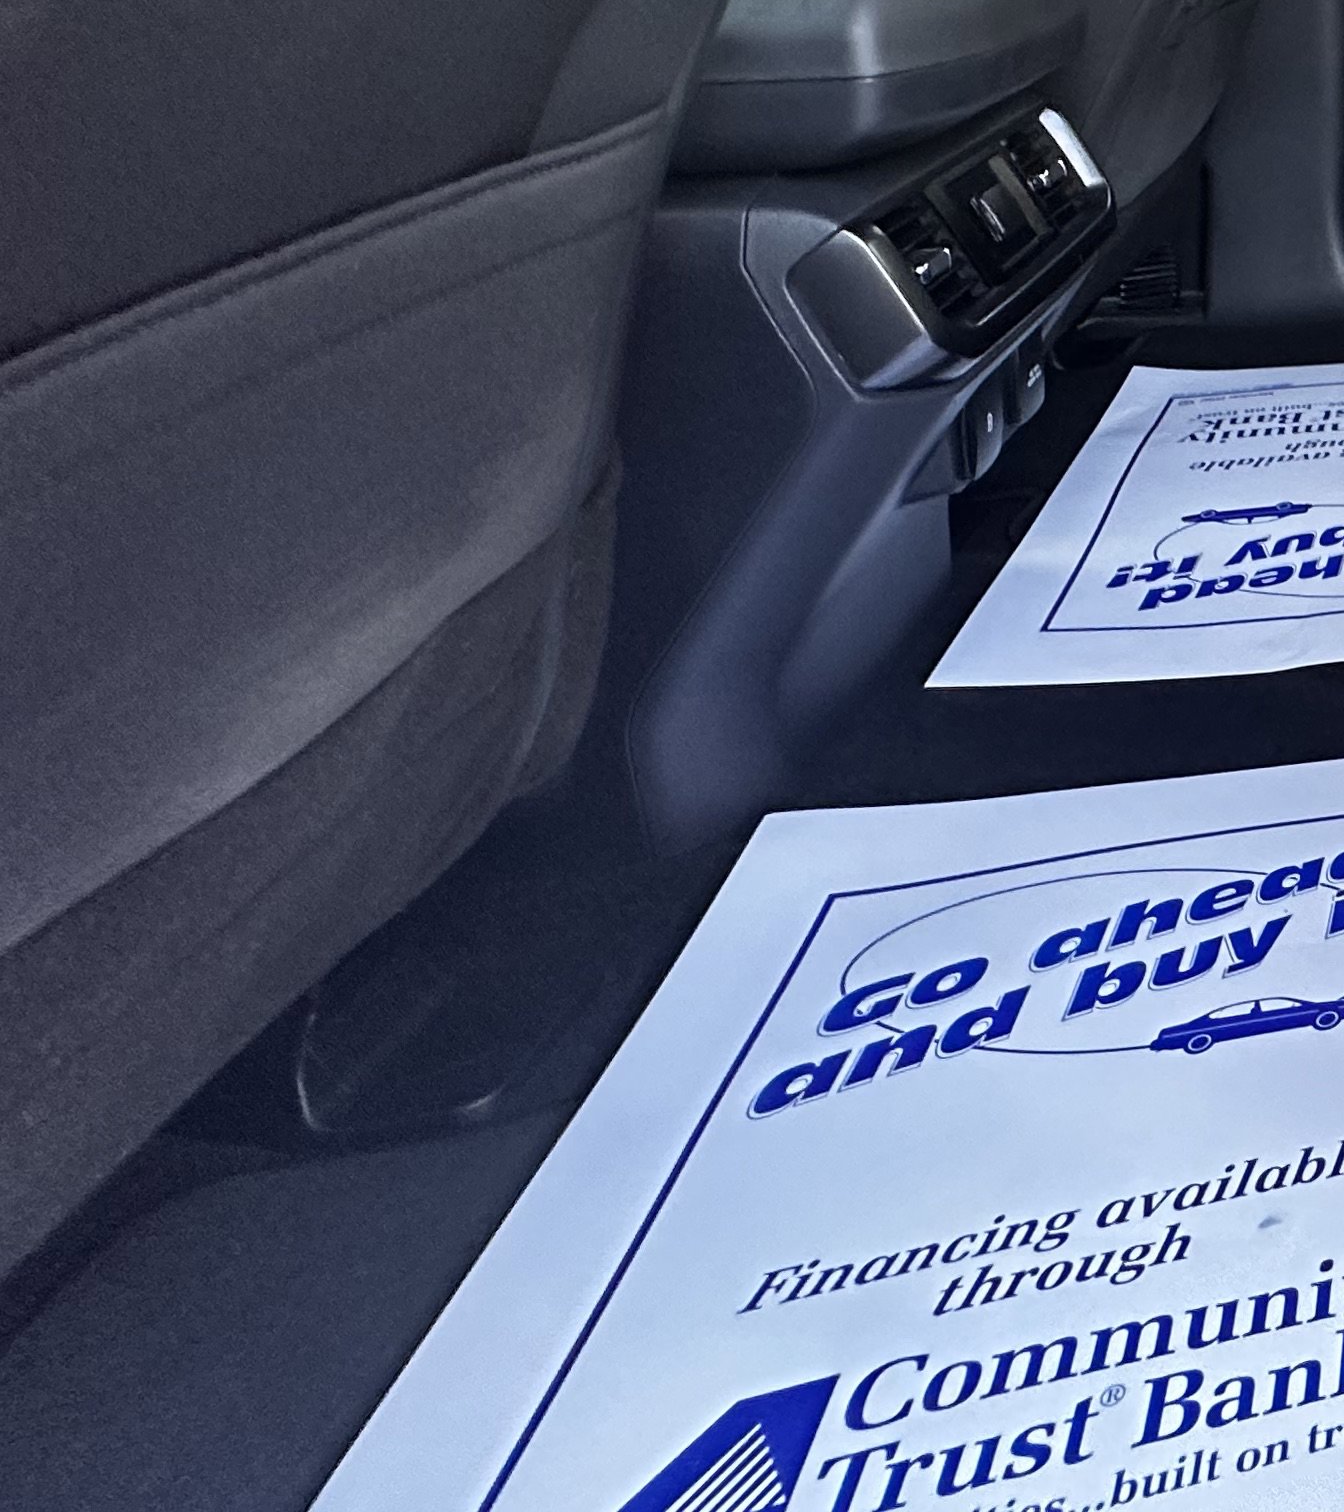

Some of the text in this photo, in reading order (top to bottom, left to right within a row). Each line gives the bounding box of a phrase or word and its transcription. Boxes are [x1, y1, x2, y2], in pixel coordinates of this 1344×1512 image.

[1201, 412, 1302, 431] Bank
[1189, 451, 1331, 472] available
[1106, 552, 1203, 588] it!
[746, 985, 1031, 1120] and
[1062, 914, 1293, 1021] buy
[817, 957, 989, 1037] Go
[736, 1208, 1081, 1314] Financing
[932, 1223, 1192, 1317] through
[1237, 1435, 1290, 1474] on
